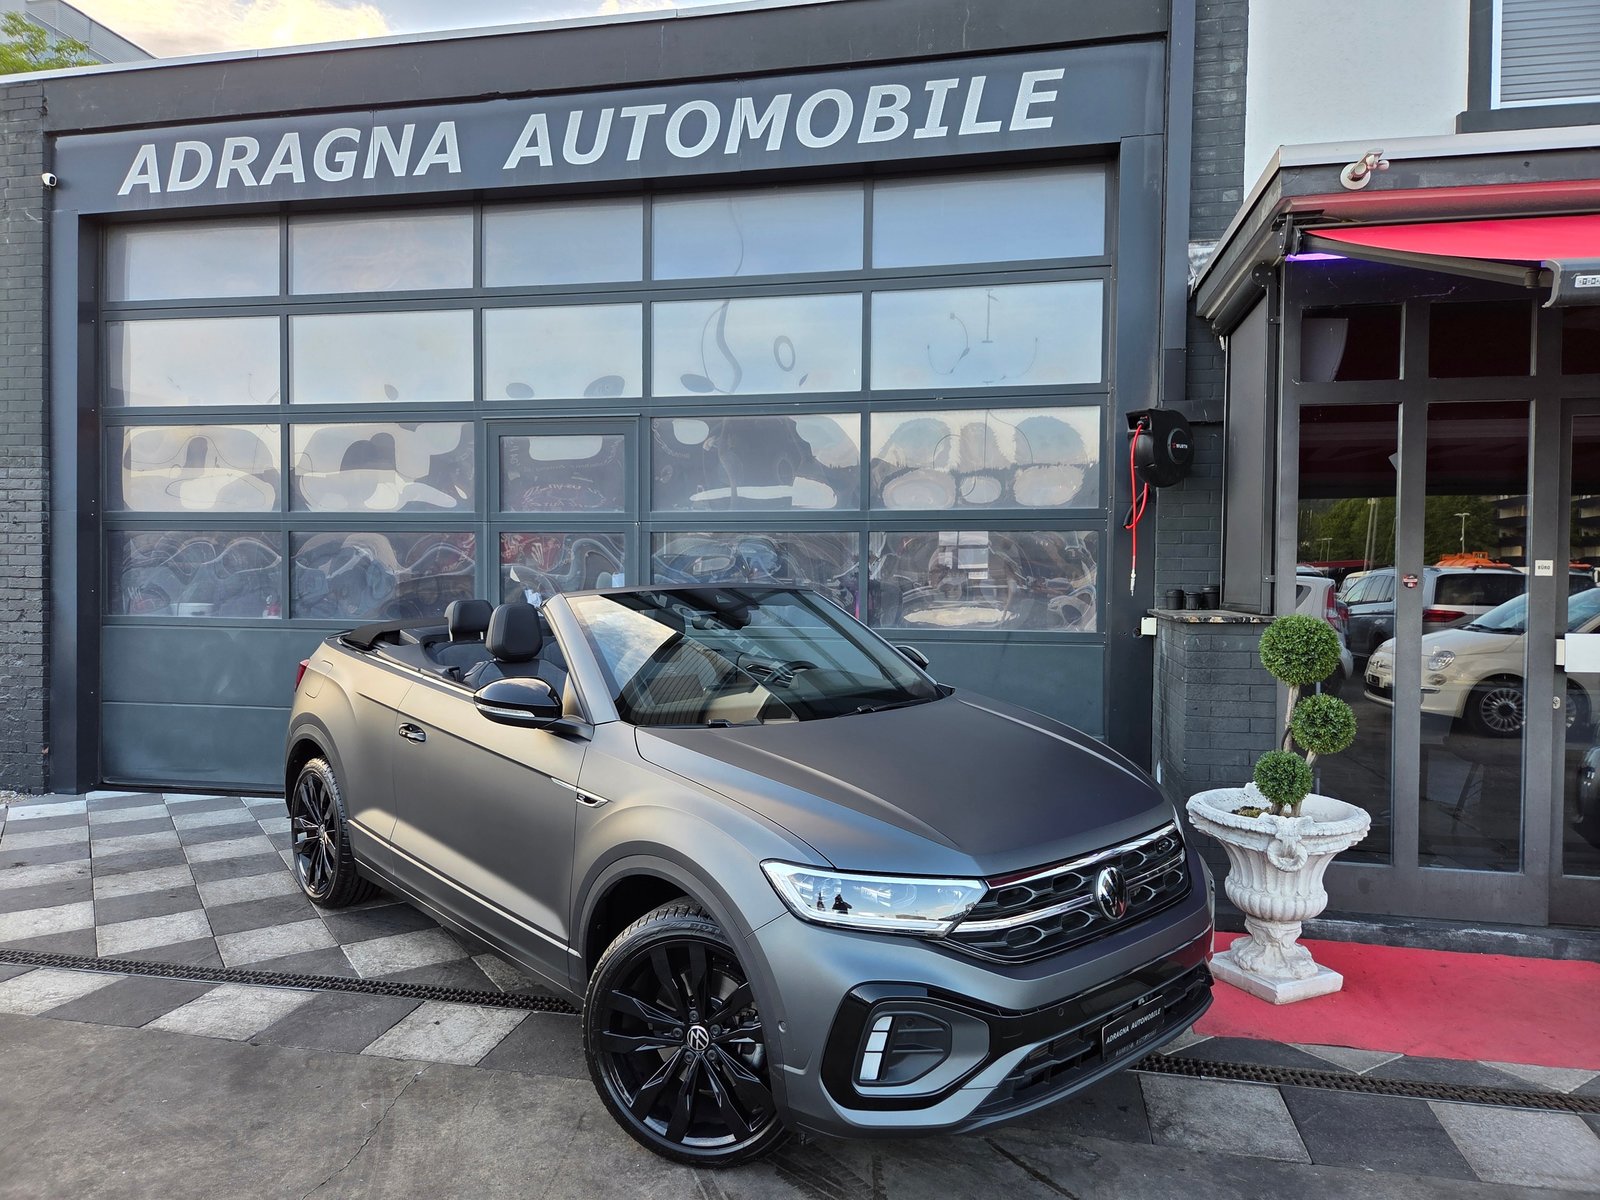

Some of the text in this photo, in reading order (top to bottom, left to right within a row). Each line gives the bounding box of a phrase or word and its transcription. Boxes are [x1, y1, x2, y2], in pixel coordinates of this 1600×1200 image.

[116, 66, 1067, 197] ADRAGNA AUTOMOBILE
[1105, 1025, 1130, 1045] ADRAGNA
[1130, 1007, 1162, 1031] AUTOMOBILE
